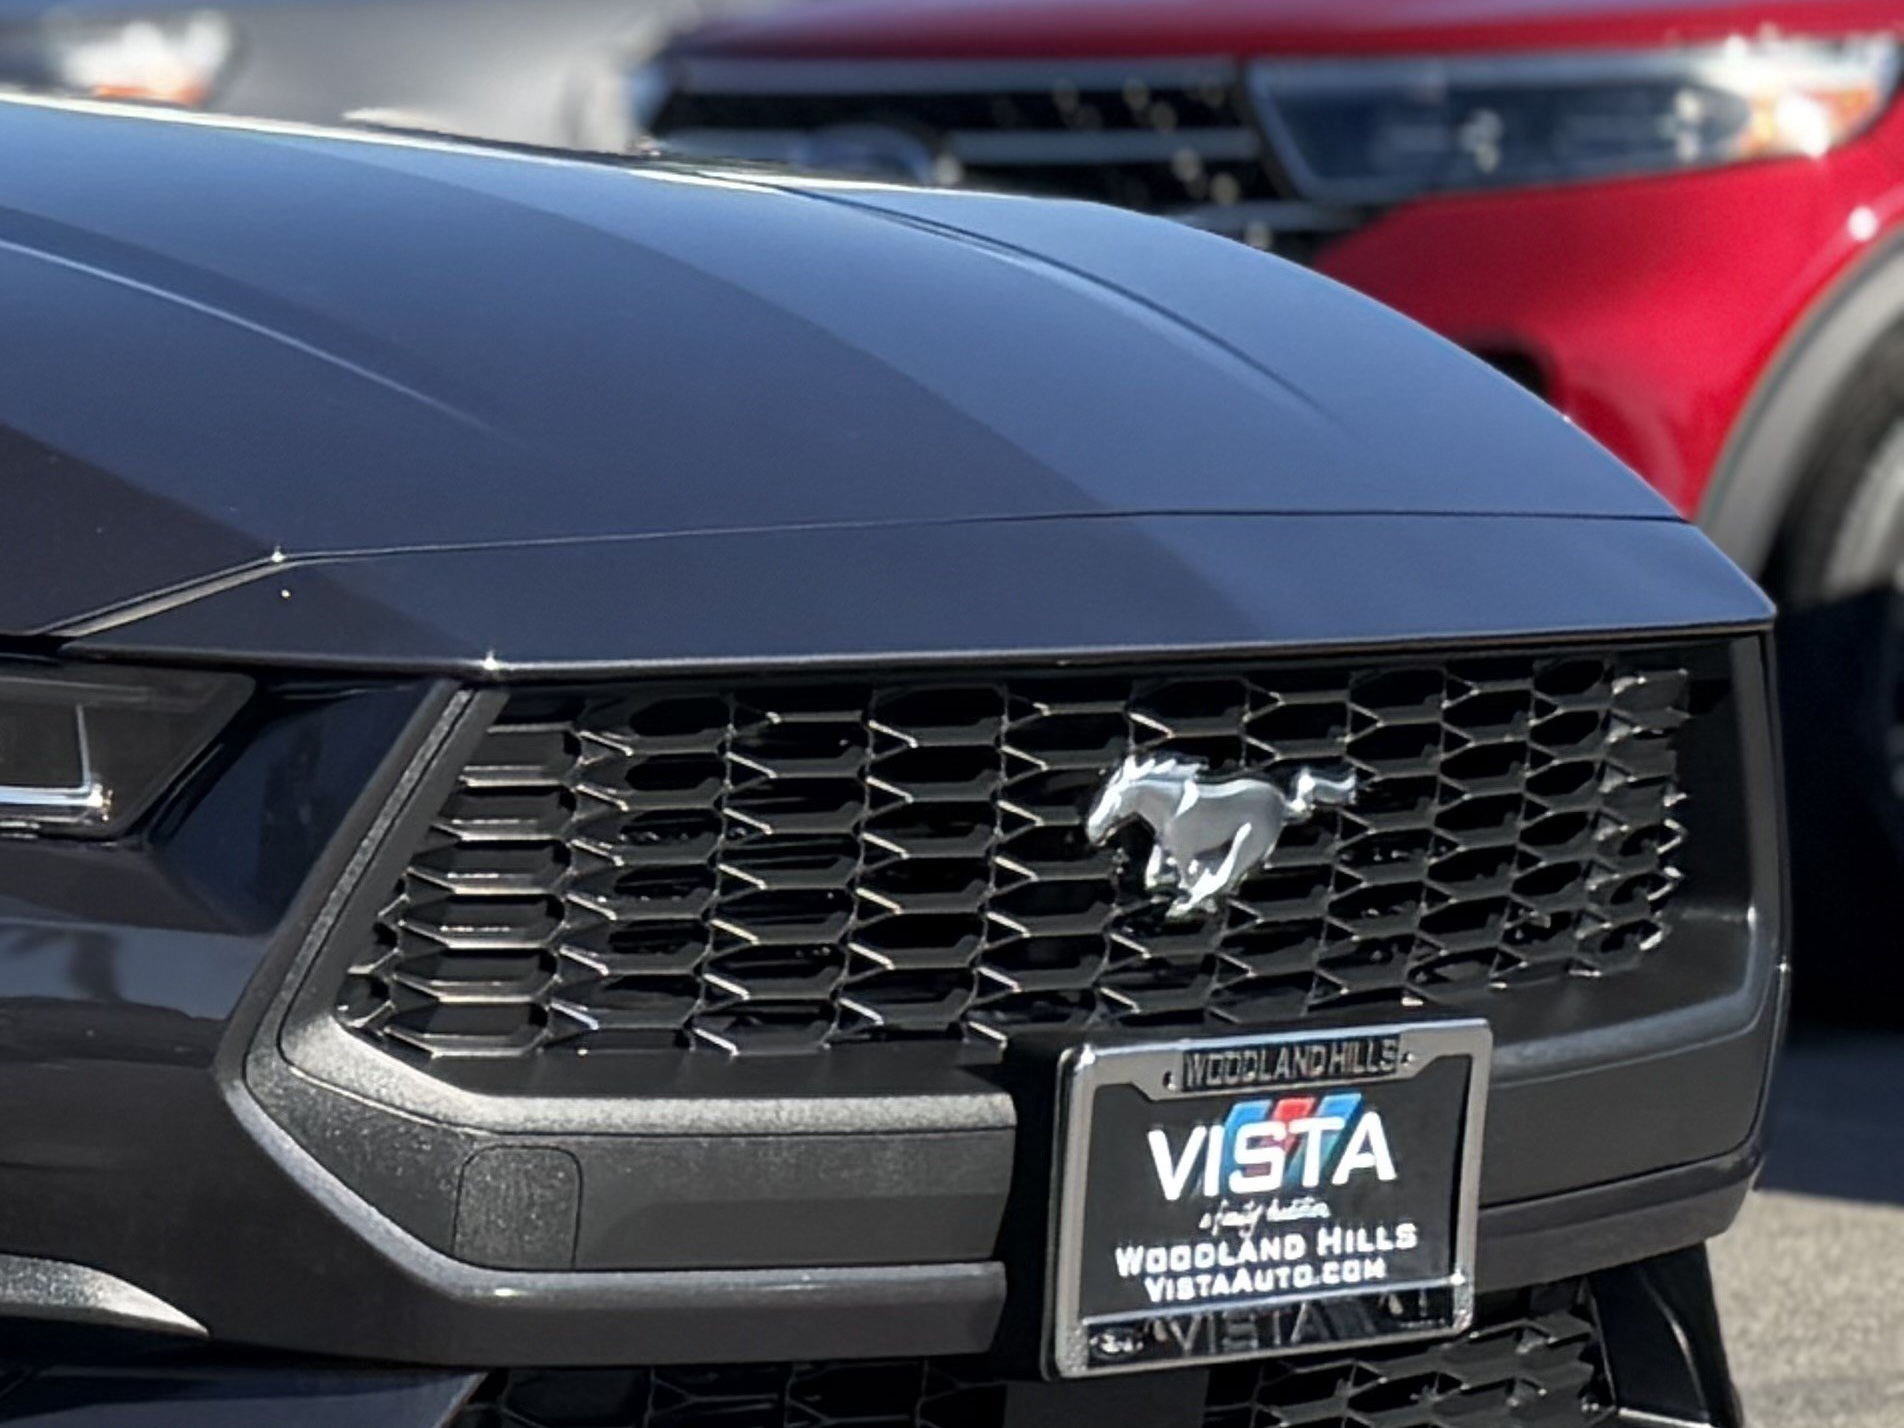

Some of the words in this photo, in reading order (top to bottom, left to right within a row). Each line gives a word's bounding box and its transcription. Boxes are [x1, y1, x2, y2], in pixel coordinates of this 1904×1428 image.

[1147, 1111, 1397, 1201] VISTA
[1114, 1233, 1306, 1277] WOODLAND
[1317, 1222, 1417, 1257] HILLS
